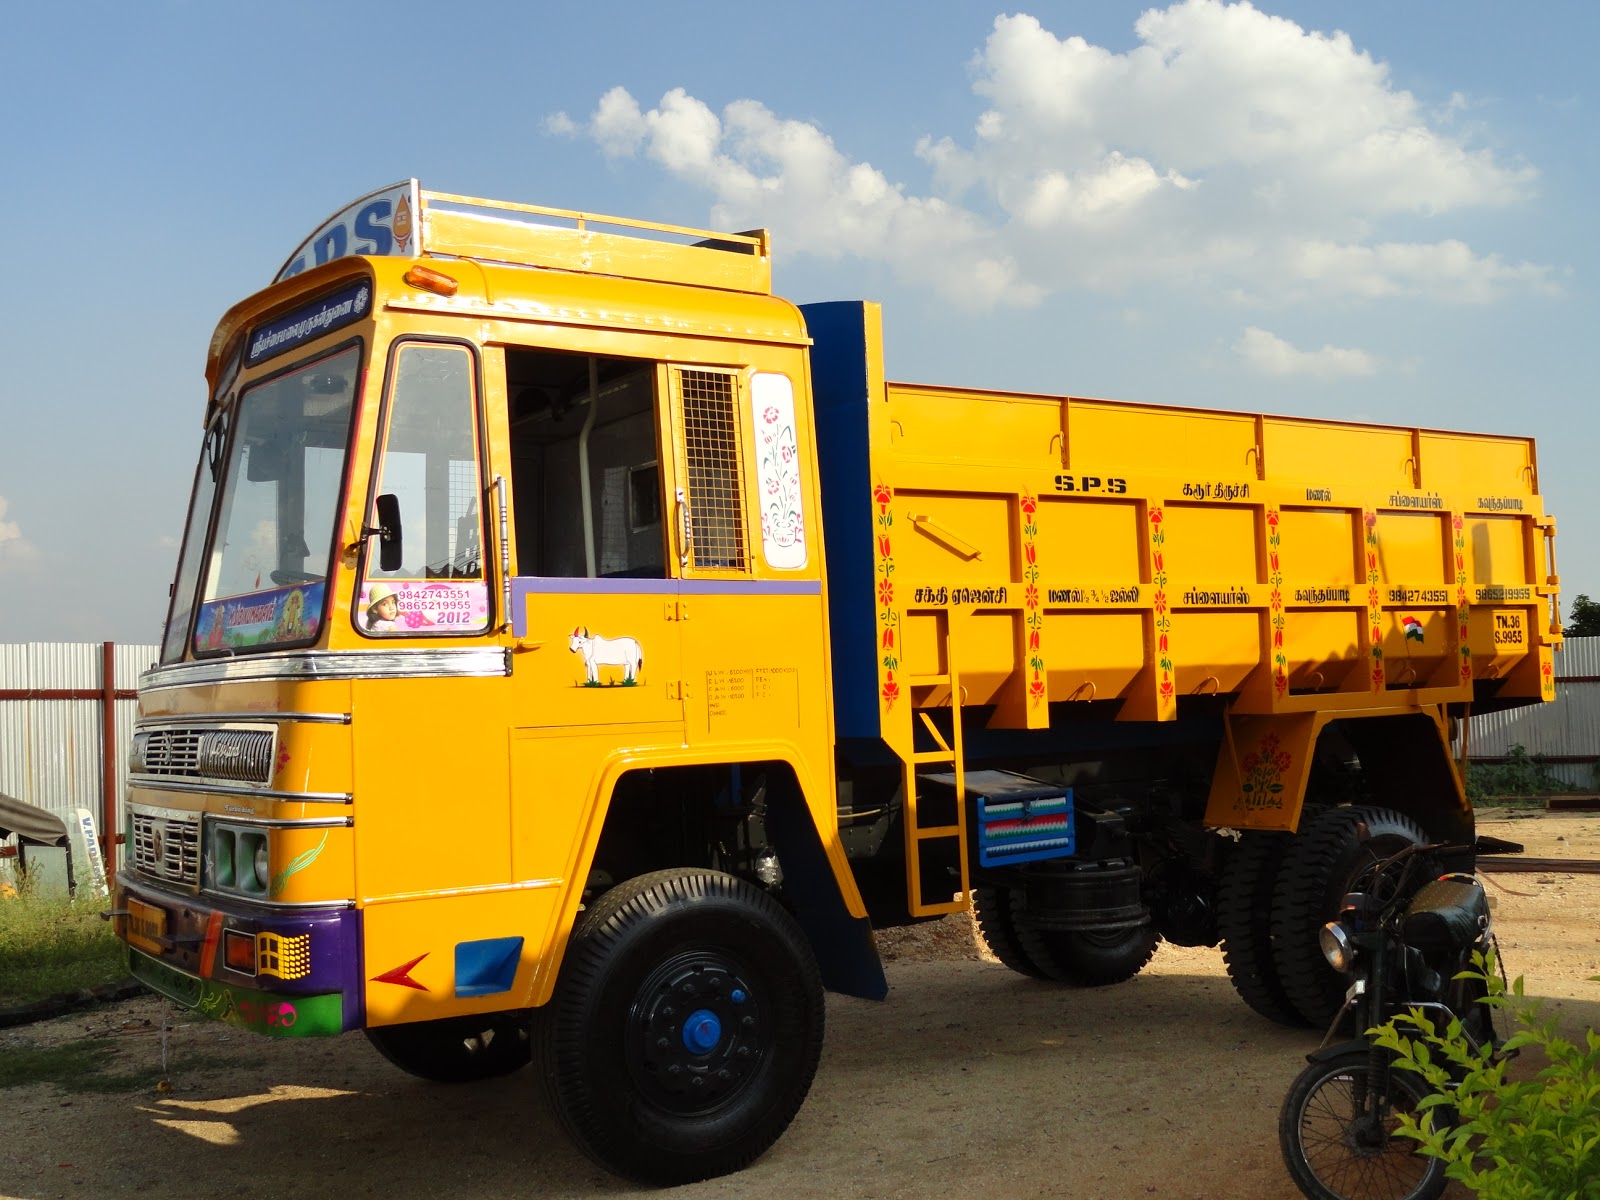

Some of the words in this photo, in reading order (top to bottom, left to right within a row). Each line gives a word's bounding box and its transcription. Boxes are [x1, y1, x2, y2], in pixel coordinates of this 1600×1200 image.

[1054, 475, 1127, 494] S.P.S
[1306, 487, 1332, 502] மணல்
[398, 590, 470, 600] 9842743551
[914, 586, 949, 606] சக்தி
[951, 586, 1008, 606] ஏஜென்சி
[1109, 586, 1140, 603] ஜல்லி
[1388, 589, 1448, 602] 9842743551
[1475, 588, 1530, 601] 9865219955
[398, 600, 471, 610] 9865219955
[436, 611, 471, 624] 2012
[1495, 615, 1520, 628] TN.36
[1494, 630, 1522, 644] S.9955
